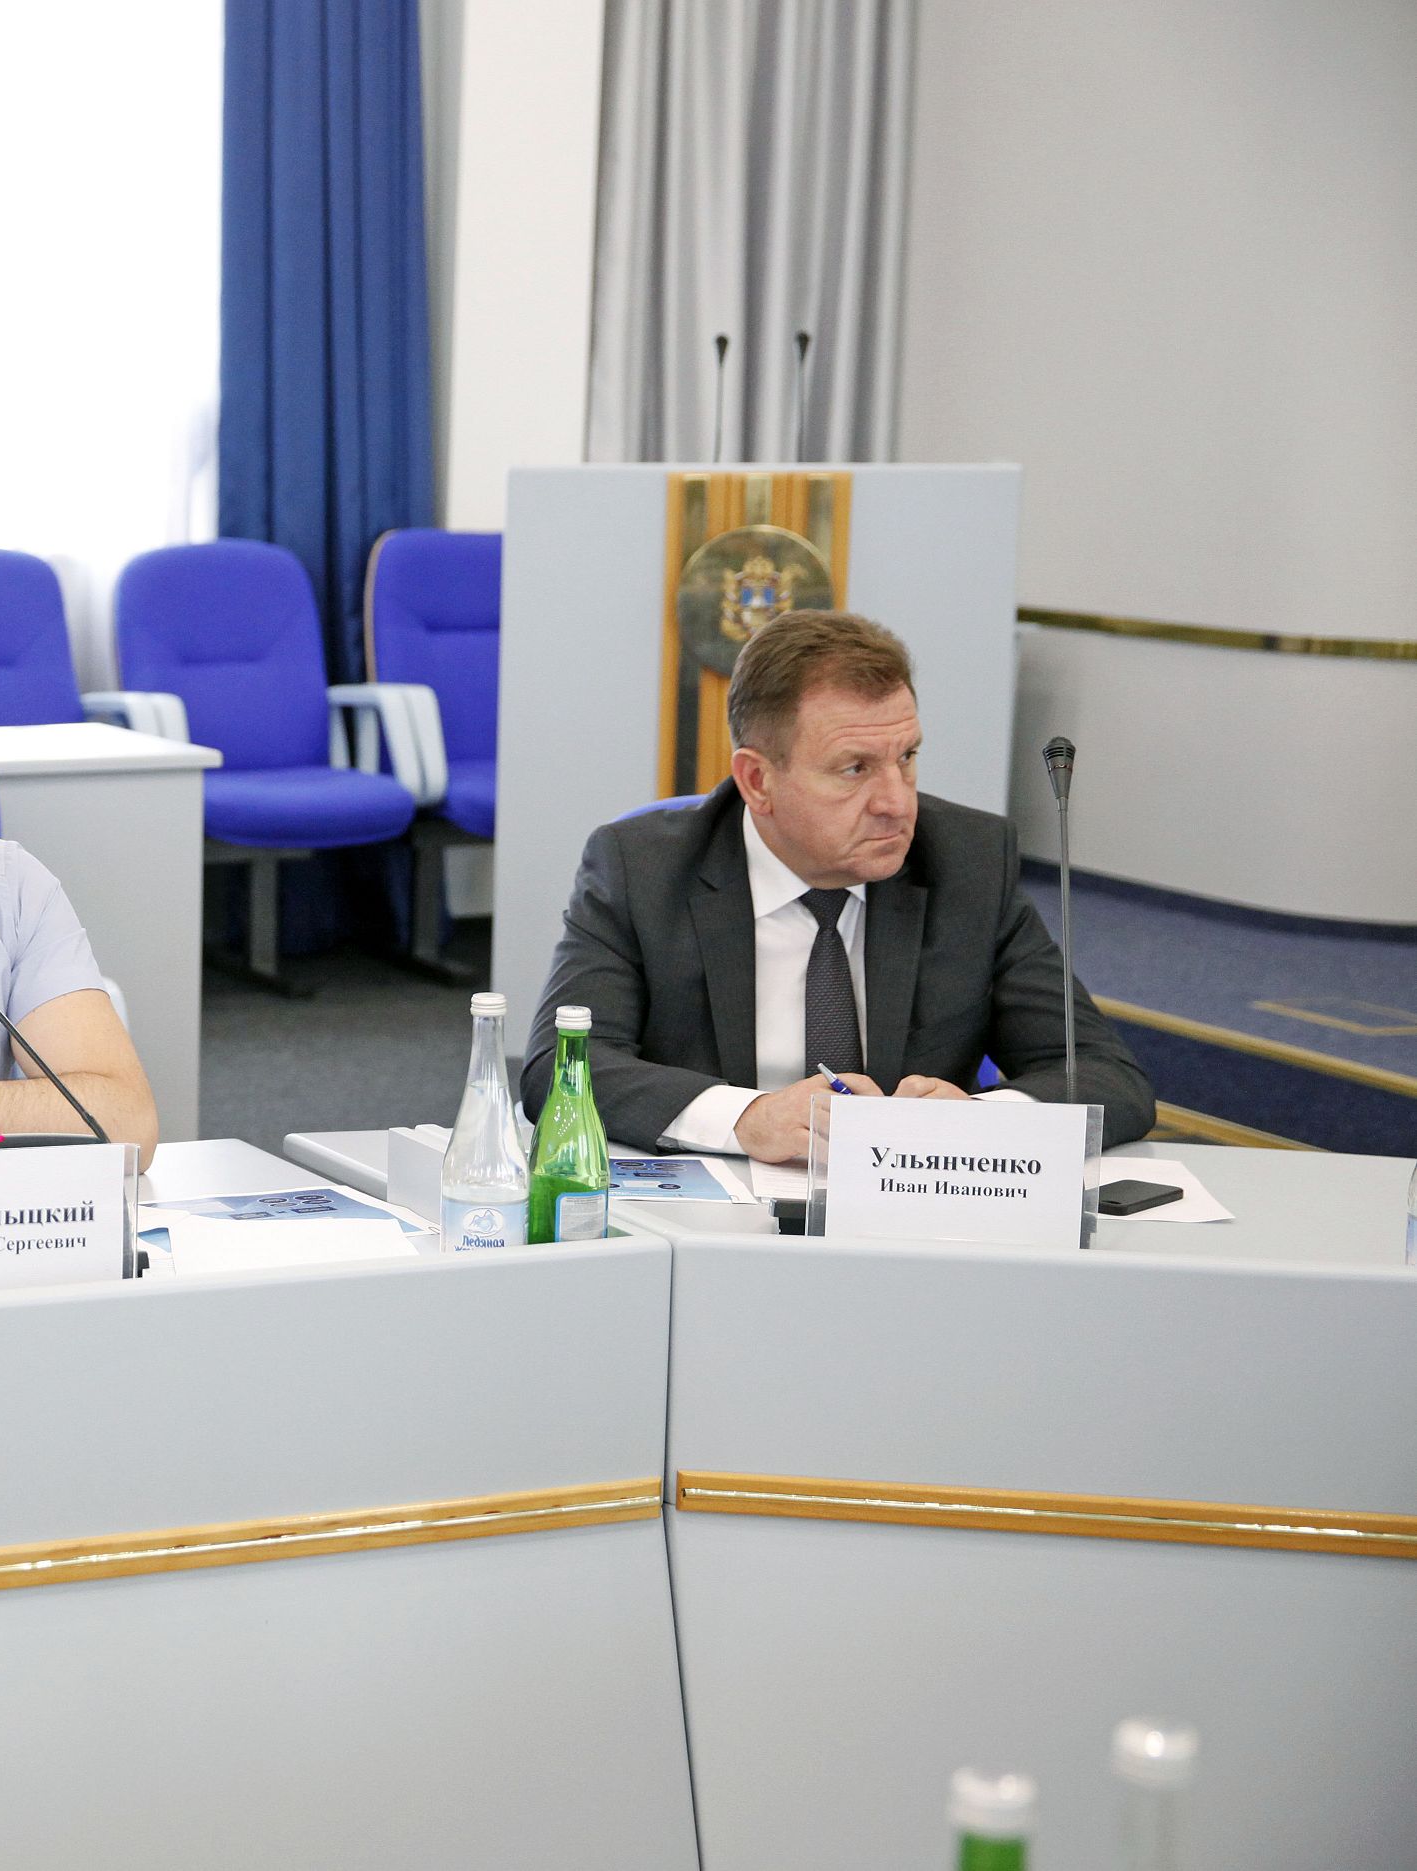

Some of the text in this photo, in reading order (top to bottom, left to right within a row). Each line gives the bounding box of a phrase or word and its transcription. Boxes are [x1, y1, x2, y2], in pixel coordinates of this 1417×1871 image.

[870, 1146, 1042, 1175] Ульянченко
[880, 1178, 1028, 1199] Иван Иванович
[462, 1234, 505, 1248] Ледяная
